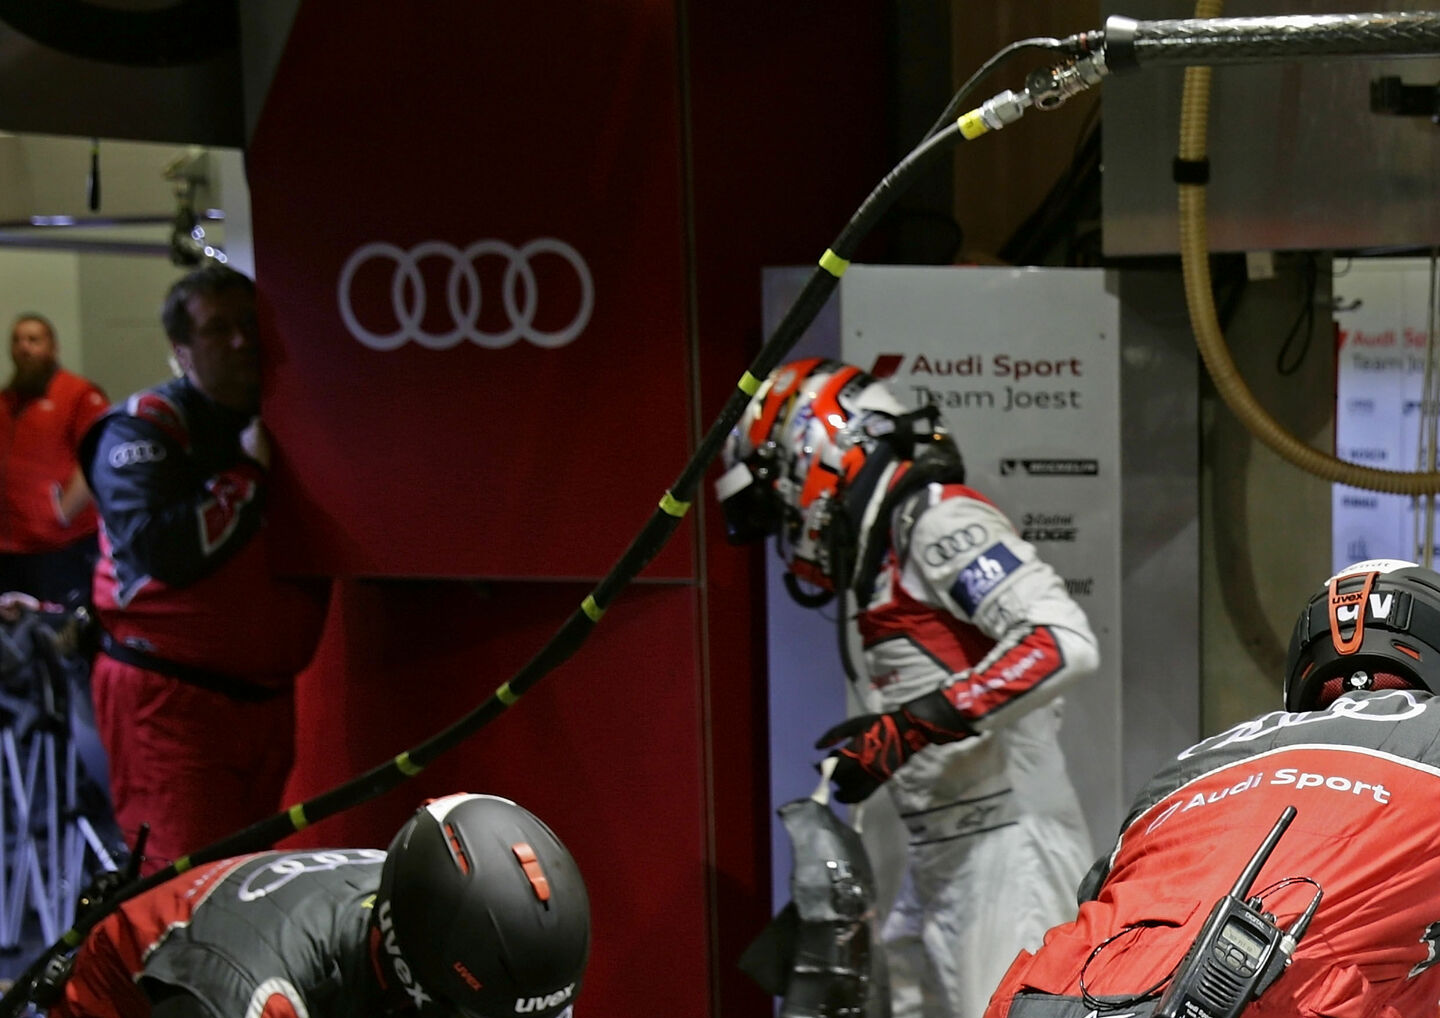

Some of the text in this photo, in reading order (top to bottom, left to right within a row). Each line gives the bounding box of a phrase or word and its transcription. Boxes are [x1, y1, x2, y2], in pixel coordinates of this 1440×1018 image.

[911, 354, 1082, 382] Audi Sport
[1004, 387, 1081, 411] Joest
[1332, 593, 1364, 604] uvex
[1181, 768, 1392, 812] Audi Sport
[379, 900, 432, 1010] uvex
[453, 961, 483, 992] uvex
[515, 982, 575, 1013] uvex
[1185, 1001, 1200, 1015] Audi
